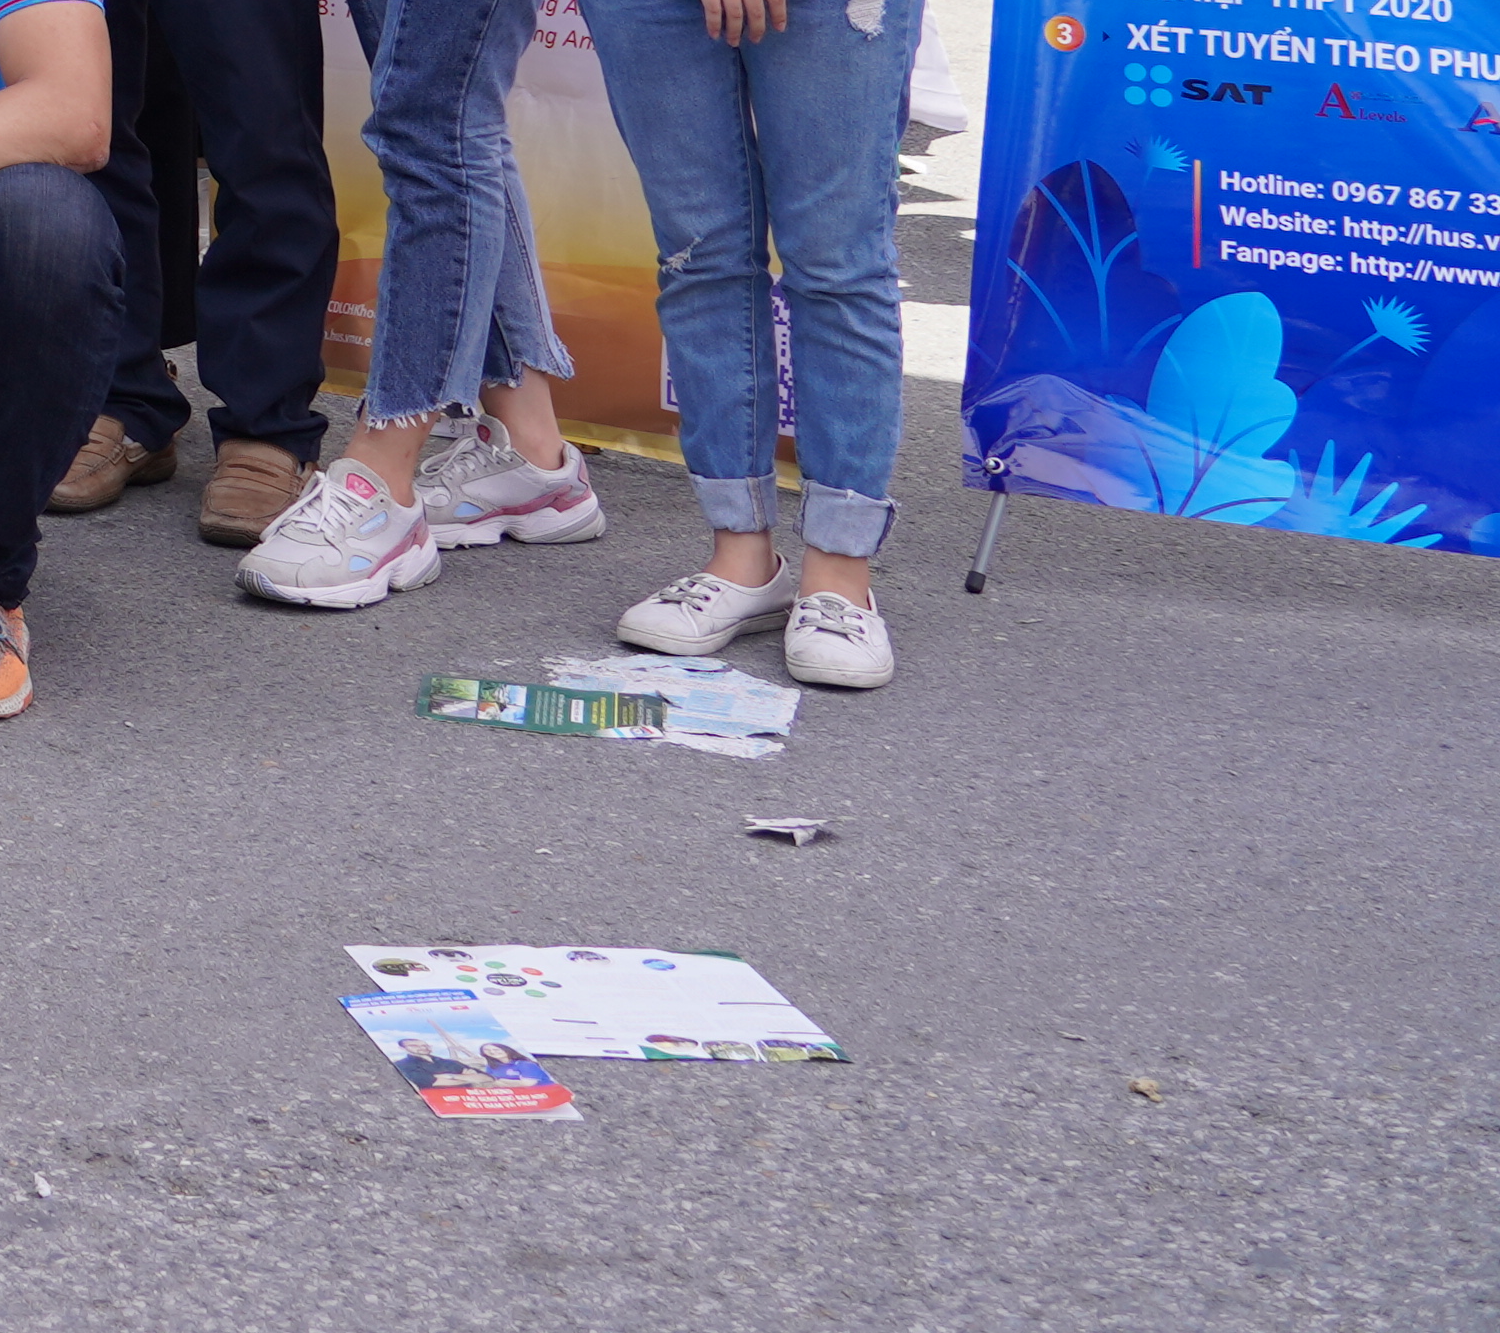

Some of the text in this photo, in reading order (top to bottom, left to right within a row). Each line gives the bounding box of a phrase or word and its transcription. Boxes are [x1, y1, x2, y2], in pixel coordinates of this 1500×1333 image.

[1181, 78, 1272, 105] SAT
[1220, 170, 1461, 211] Hotline: 0967 867
